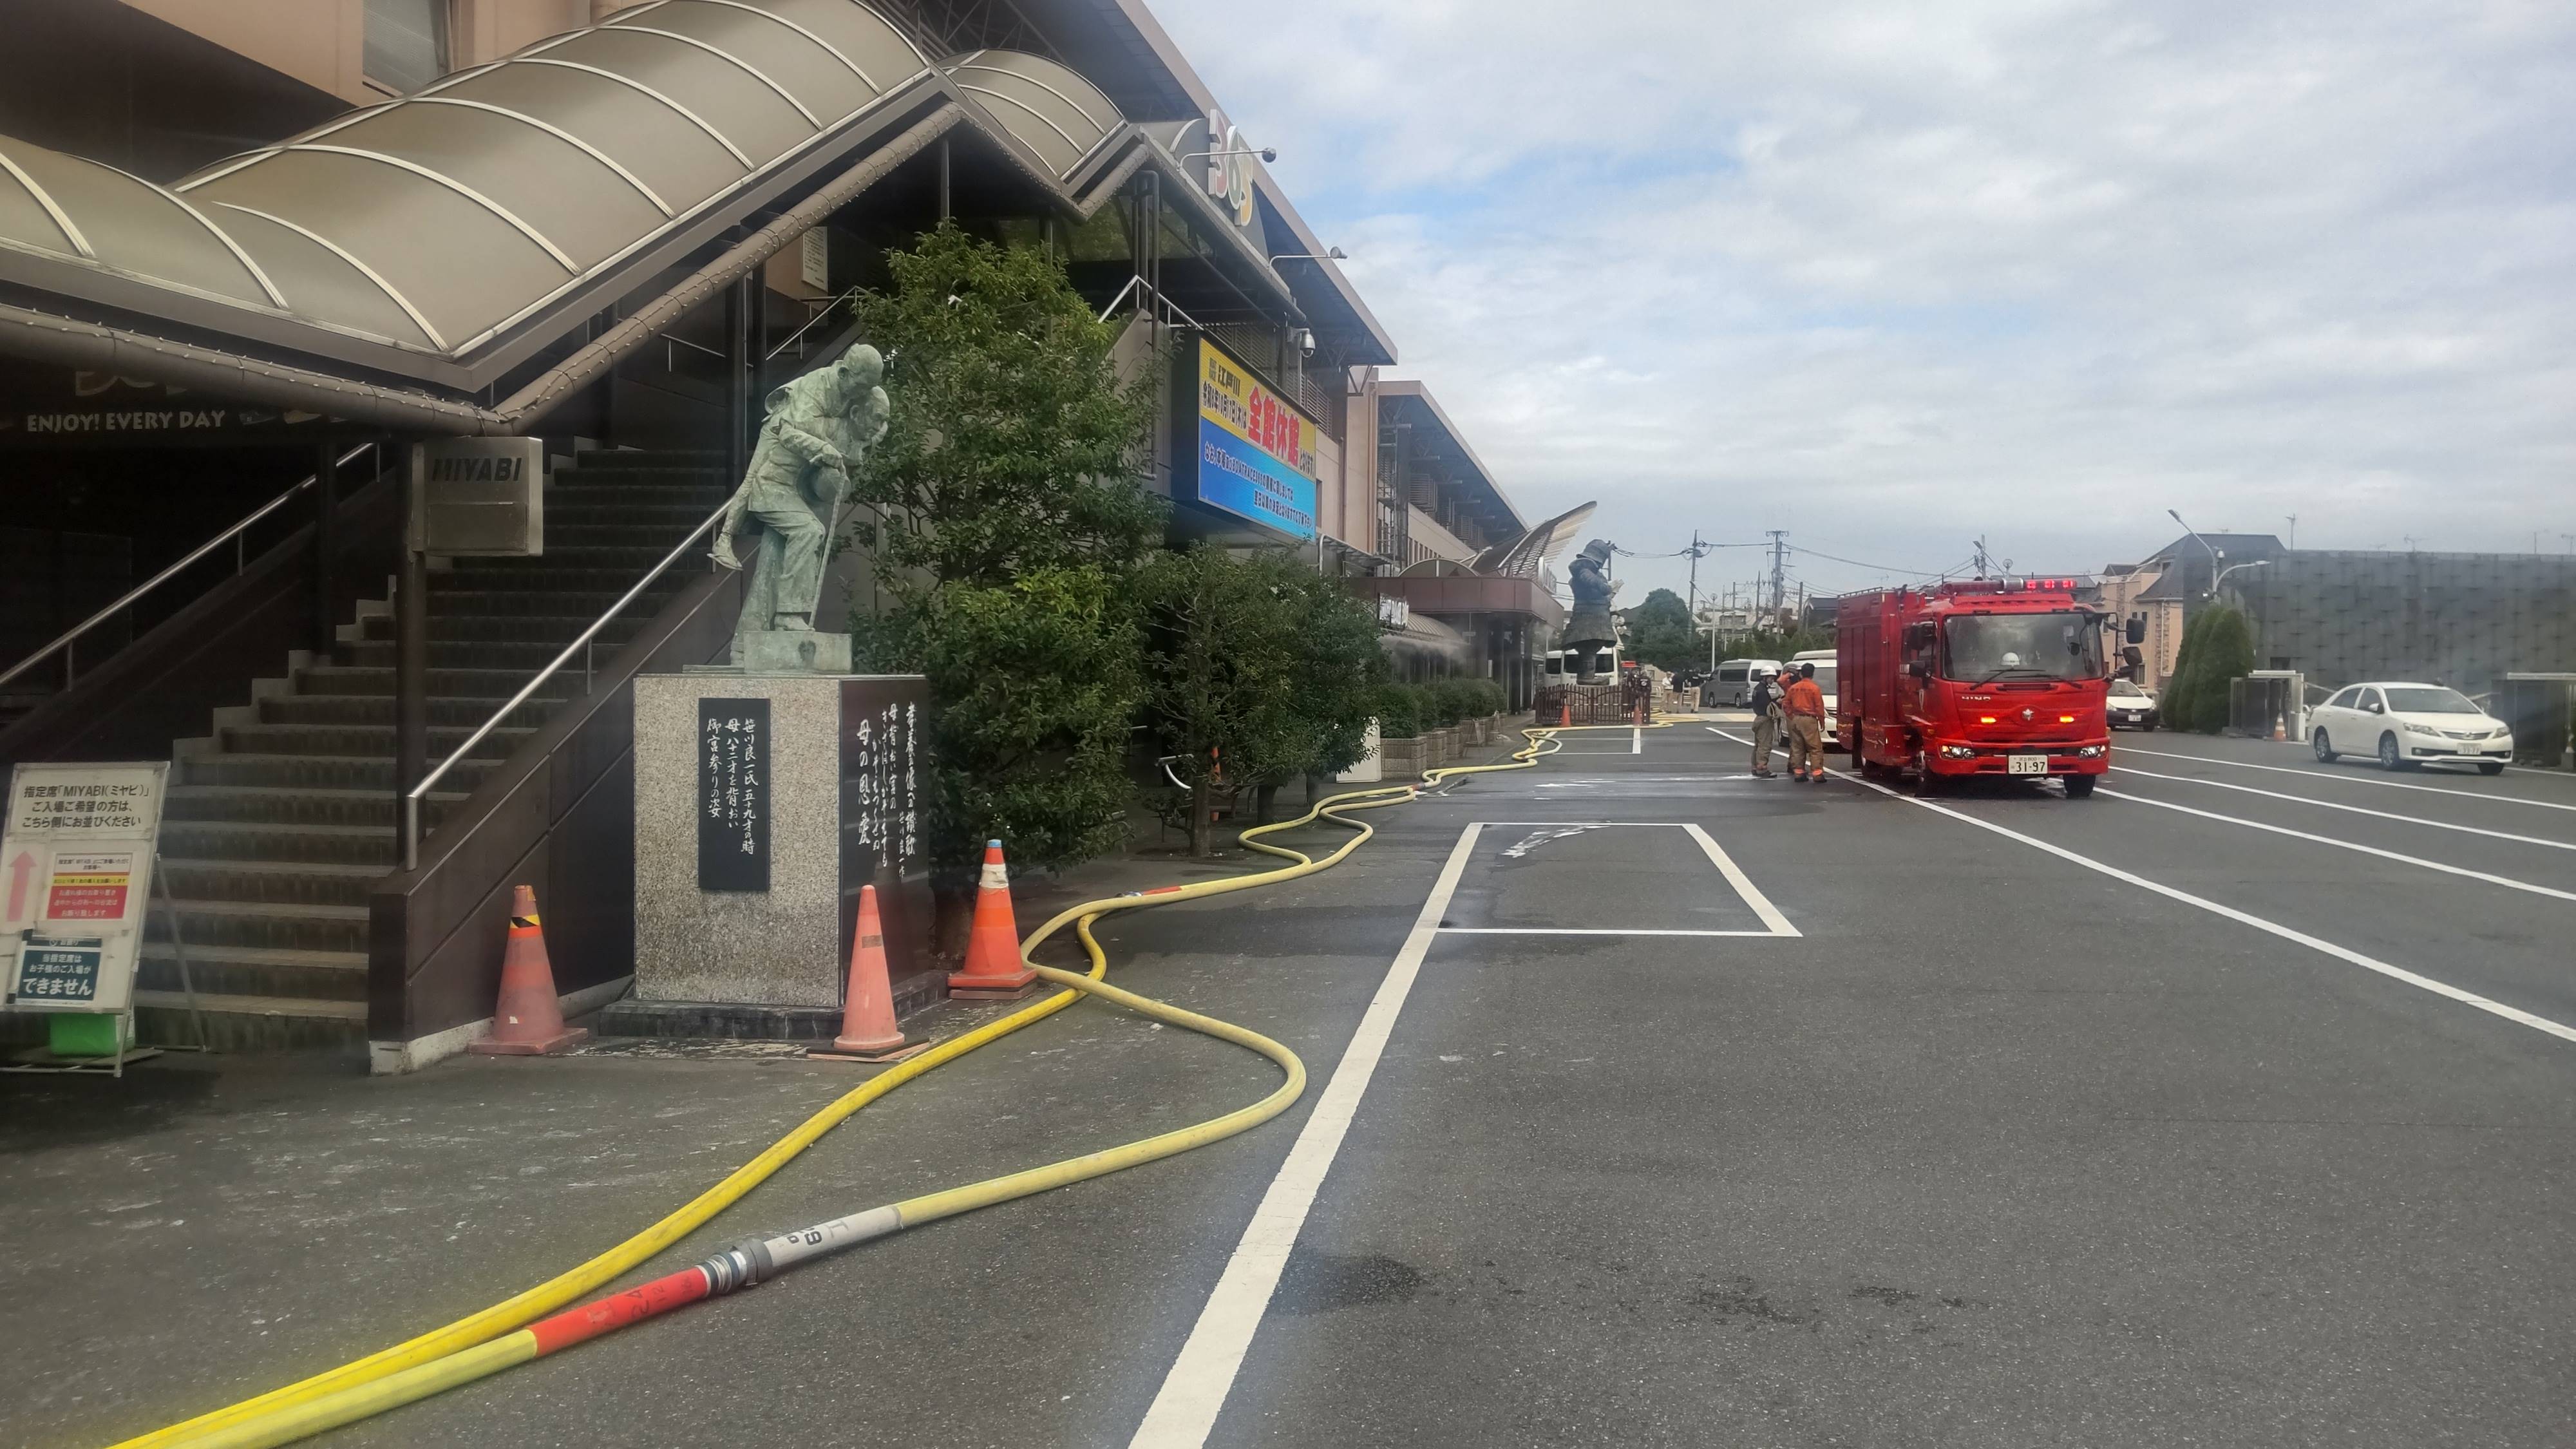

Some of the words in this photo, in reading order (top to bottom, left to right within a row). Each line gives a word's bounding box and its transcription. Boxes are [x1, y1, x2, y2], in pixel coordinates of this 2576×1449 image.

[27, 414, 100, 433] ENJOY!
[105, 411, 173, 430] EVERY
[179, 410, 225, 428] DAY
[431, 457, 522, 482] MIYABI
[2016, 762, 2045, 772] 31-97
[22, 816, 141, 828] こちら側にお並びください
[43, 954, 82, 963] 当指定席は
[29, 965, 91, 974] お子様のご入場が
[23, 978, 92, 996] できません
